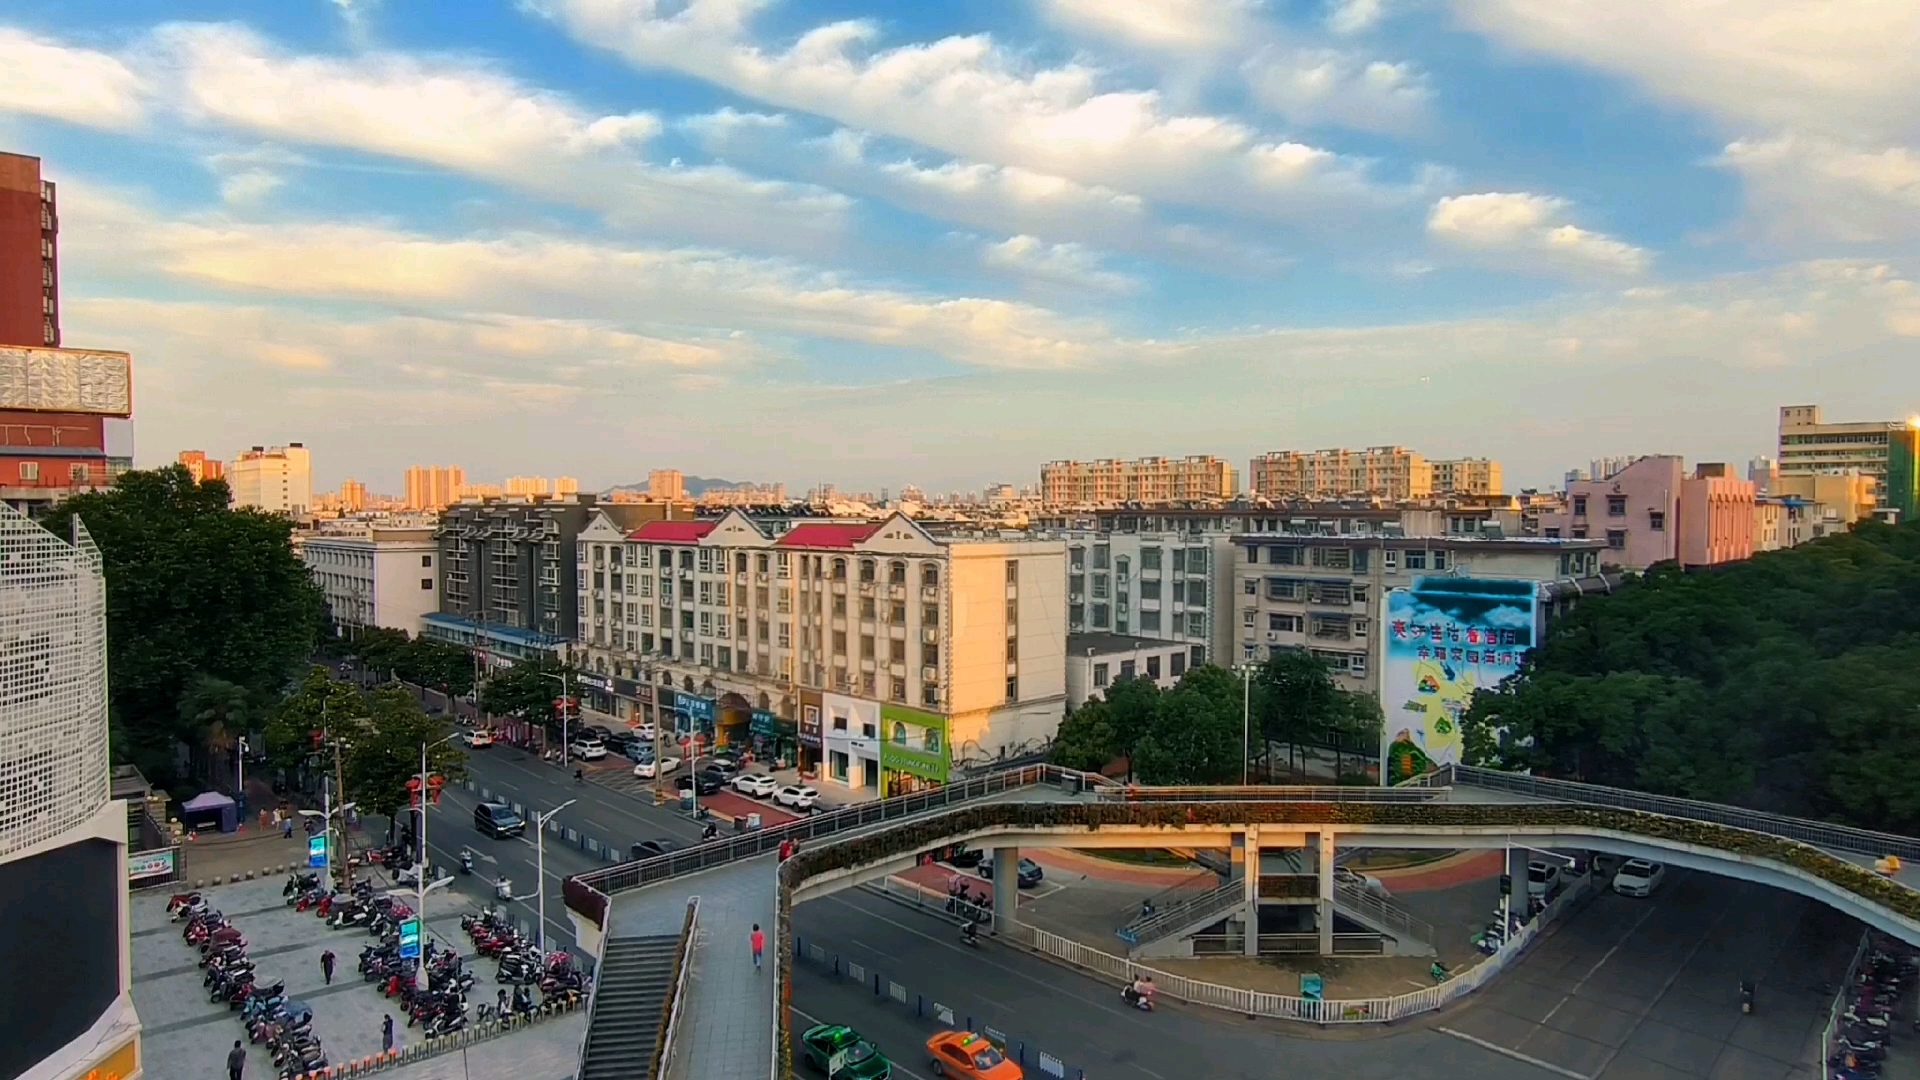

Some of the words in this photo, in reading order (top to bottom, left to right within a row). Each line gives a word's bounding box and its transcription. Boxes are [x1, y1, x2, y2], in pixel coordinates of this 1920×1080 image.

[1392, 619, 1515, 645] 美好生活看信阳
